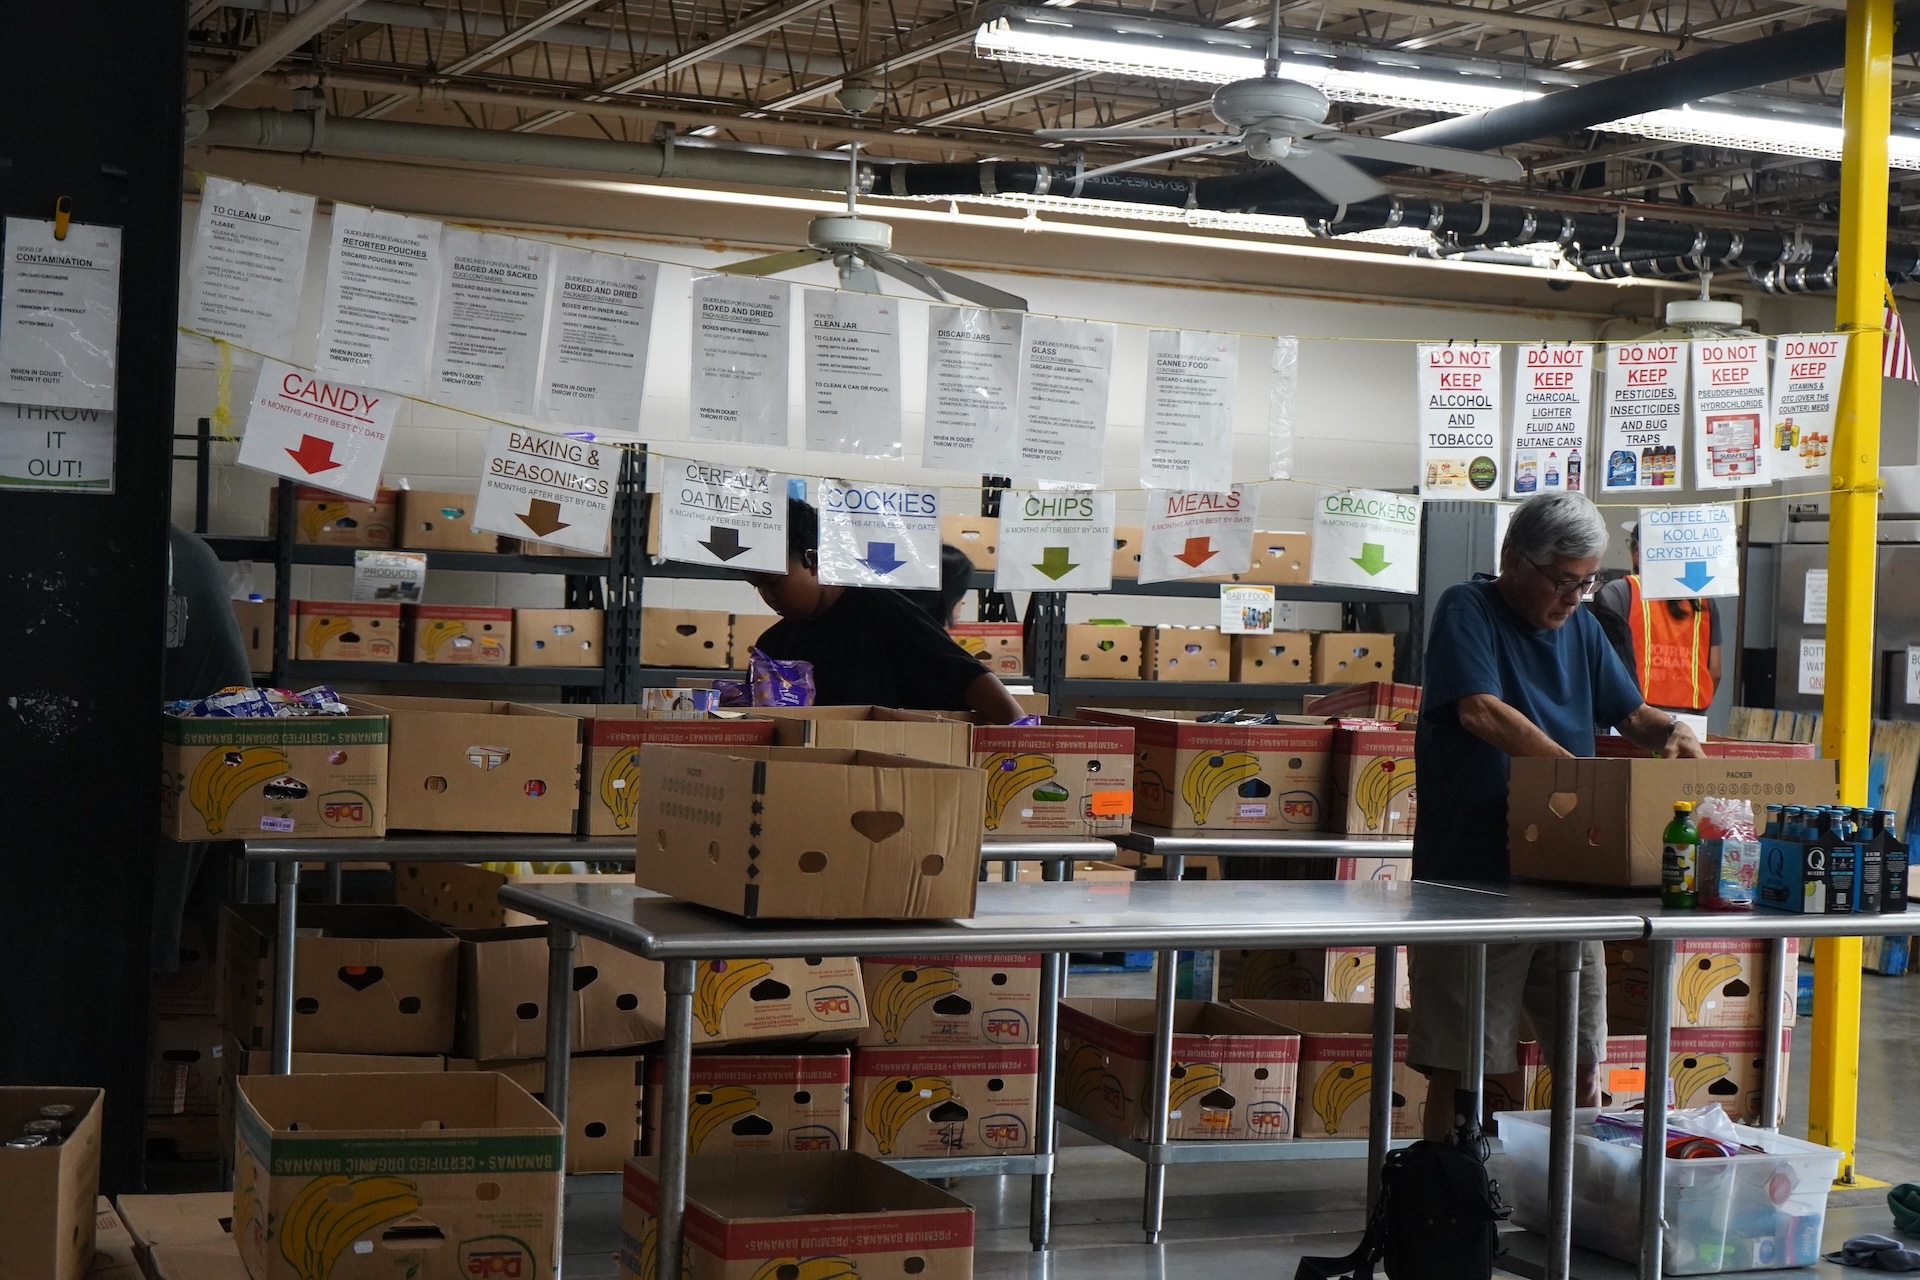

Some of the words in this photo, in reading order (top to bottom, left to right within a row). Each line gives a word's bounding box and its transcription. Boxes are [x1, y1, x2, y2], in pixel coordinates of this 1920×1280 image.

[213, 205, 225, 214] TO
[227, 209, 257, 220] CLEAN
[258, 214, 271, 222] UP
[210, 220, 236, 229] PLEASE:
[342, 237, 386, 250] RETORTED
[388, 245, 427, 257] POUCHES
[16, 253, 93, 267] CONTAMINATION
[454, 263, 487, 273] BAGGED
[489, 267, 505, 276] AND
[506, 271, 538, 280] SACKED
[564, 282, 592, 293] BOXED
[594, 287, 611, 295] AND
[613, 289, 637, 299] DRIED
[702, 303, 730, 313] BOXED
[732, 307, 748, 315] AND
[750, 310, 773, 318] DRIED
[814, 320, 840, 328] CLEAN
[938, 330, 970, 339] DISCARD
[972, 333, 991, 341] JARS
[1032, 347, 1057, 355] GLASS
[1620, 347, 1643, 361] DO
[1648, 346, 1678, 360] NOT
[1702, 347, 1723, 361] DO
[1727, 346, 1757, 359] NOT
[1786, 342, 1805, 356] DO
[1808, 341, 1838, 354] NOT
[1157, 359, 1187, 368] CANNED
[1188, 361, 1208, 369] FOOD
[1431, 350, 1454, 364] DO
[1459, 350, 1490, 364] NOT
[1528, 350, 1548, 364] DO
[1553, 350, 1584, 364] NOT
[1628, 368, 1667, 383] KEEP
[1712, 368, 1749, 382] KEEP
[1790, 362, 1826, 376] KEEP
[1441, 373, 1482, 387] KEEP
[1535, 372, 1573, 386] KEEP
[282, 373, 379, 416] CANDY
[1526, 392, 1579, 402] CHARCOAL,
[1615, 388, 1677, 399] PESTICIDES,
[1698, 387, 1764, 397] PSEUDOEPHEDRINE
[1781, 395, 1794, 403] OTC
[1795, 394, 1815, 402] (OVER
[1430, 395, 1492, 406] ALCOHOL
[1700, 399, 1763, 410] HYDROCHLORIDE
[17, 404, 98, 421] THROW
[1532, 408, 1572, 417] LIGHTER
[1610, 403, 1680, 415] INSECTICIDES
[1778, 405, 1810, 414] COUNTER)
[261, 398, 266, 406] 6
[267, 400, 302, 416] MONTHS
[303, 411, 328, 424] AFTER
[330, 419, 350, 431] BEST
[352, 425, 363, 434] BY
[364, 429, 386, 440] DATE
[1448, 414, 1475, 425] AND
[1620, 420, 1643, 430] AND
[1645, 419, 1668, 429] BUG
[1526, 422, 1553, 432] FLUID
[1555, 422, 1576, 431] AND
[47, 431, 66, 448] IT
[1429, 434, 1493, 445] TOBACCO
[1517, 437, 1555, 447] BUTANE
[1557, 436, 1582, 446] CANS
[1626, 434, 1660, 444] TRAPS
[509, 432, 582, 462] BAKING
[588, 450, 599, 466] &
[28, 459, 82, 478] OUT!
[491, 457, 609, 495] SEASONINGS
[686, 464, 753, 488] CEREAL
[758, 476, 768, 490] &
[494, 481, 527, 494] MONTHS
[528, 488, 552, 499] AFTER
[554, 494, 573, 503] BEST
[586, 500, 606, 510] DATE
[681, 488, 772, 516] OATMEALS
[828, 488, 936, 514] COOKIES
[1167, 491, 1240, 514] MEALS
[1025, 497, 1093, 517] CHIPS
[1326, 496, 1417, 521] CRACKERS
[676, 509, 706, 520] MONTHS
[707, 515, 730, 525] AFTER
[731, 519, 751, 528] BEST
[763, 522, 782, 531] DATE
[1650, 510, 1706, 523] COFFEE,
[1708, 509, 1729, 521] TEA,
[1156, 522, 1183, 530] MONTHS
[1328, 520, 1359, 528] MONTHS
[1663, 528, 1699, 541] KOOL
[1702, 527, 1722, 539] AID,
[1646, 546, 1704, 559] CRYSTAL
[375, 557, 407, 565] PAPER
[363, 568, 418, 578] PRODUCTS
[1226, 592, 1247, 600] BABY
[1248, 592, 1270, 600] FOOD
[184, 733, 232, 744] BANANAS
[236, 733, 278, 744] ORGANIC
[282, 733, 328, 744] CERTIFIED
[338, 732, 383, 743] BANANAS
[324, 806, 362, 822] Dole
[1284, 803, 1312, 816] Dole
[1768, 847, 1783, 878] Q
[1807, 849, 1825, 870] Q
[814, 1000, 850, 1015] Dole
[987, 1022, 1019, 1036] Dole
[1252, 1114, 1280, 1127] Dole
[986, 1126, 1018, 1142] Dole
[275, 1158, 340, 1173] BANANAS
[345, 1158, 404, 1172] ORGANIC
[411, 1155, 475, 1171] CERTIFIED
[489, 1154, 552, 1170] BANANAS
[801, 1236, 848, 1248] PREMIUM
[857, 1233, 903, 1246] BANANAS
[905, 1229, 951, 1242] PREMIUM
[750, 1238, 797, 1250] BANANAS
[468, 1256, 521, 1279] Dole
